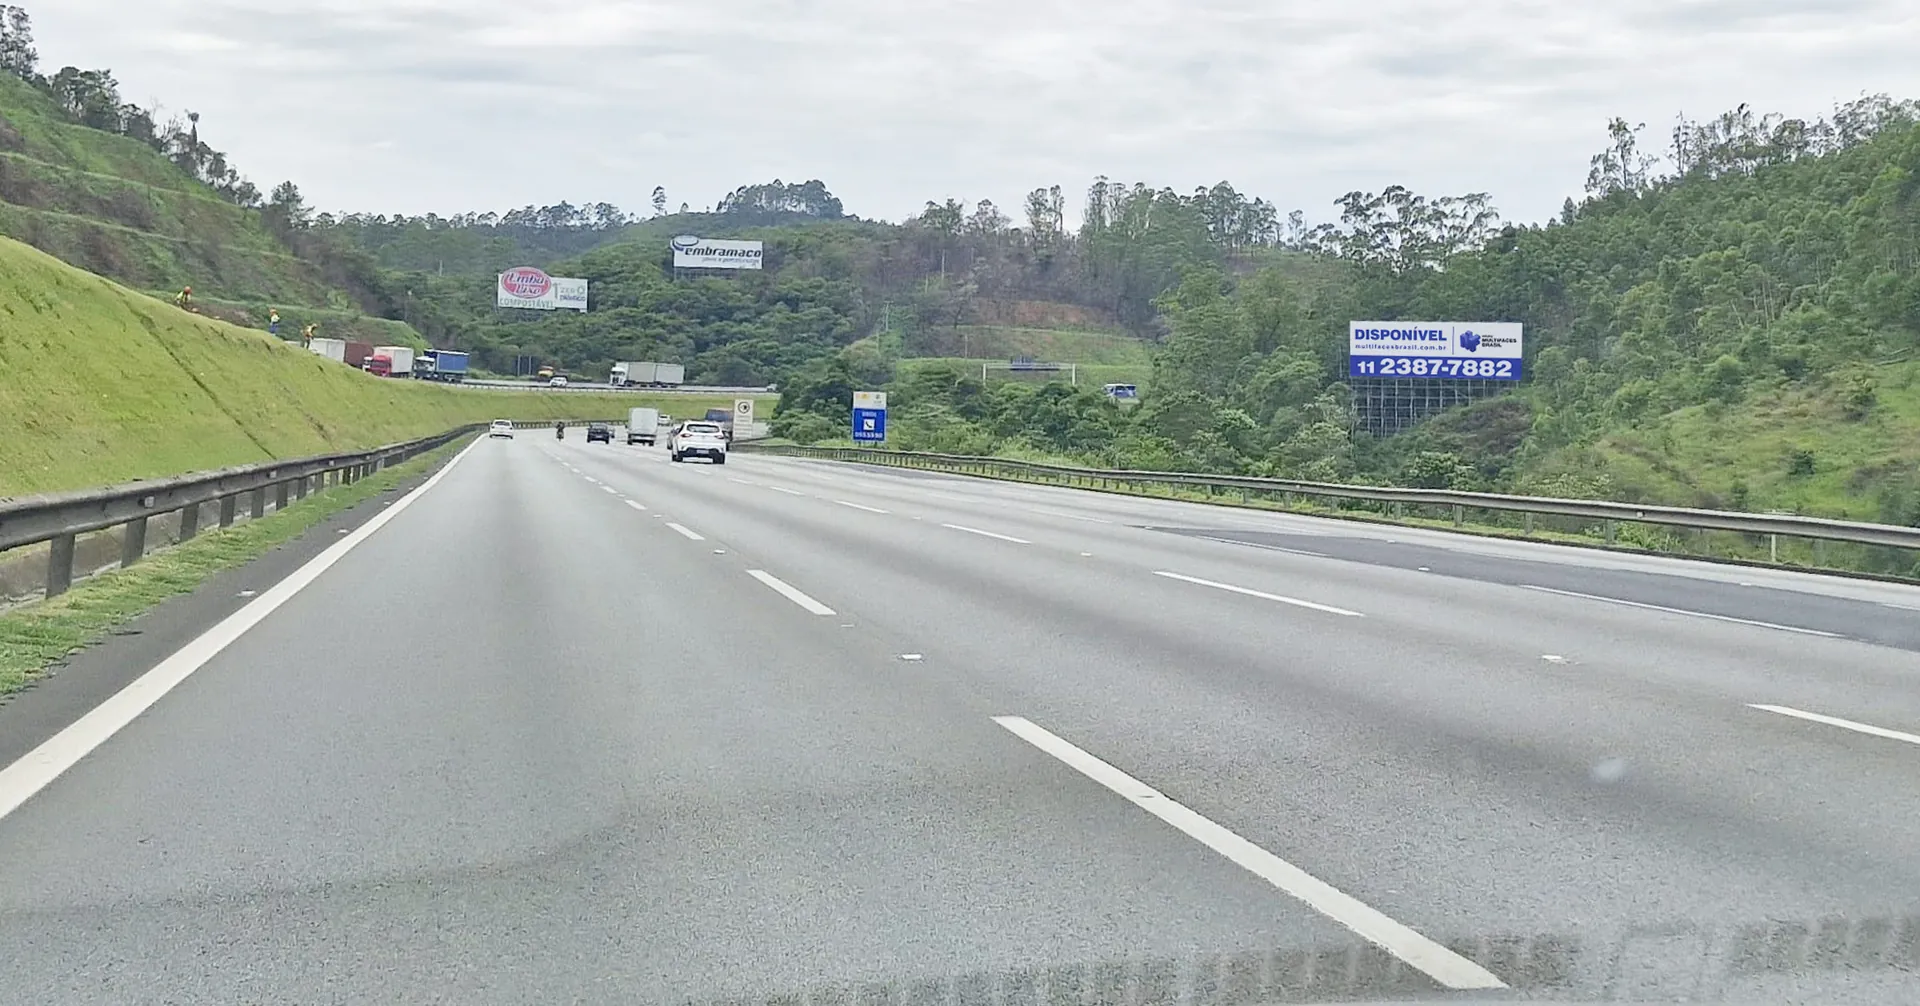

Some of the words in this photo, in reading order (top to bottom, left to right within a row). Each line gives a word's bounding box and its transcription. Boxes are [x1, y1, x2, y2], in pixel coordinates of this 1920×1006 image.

[685, 246, 761, 257] embramaco
[499, 298, 553, 308] COMPOSTÁVEL
[1355, 327, 1447, 341] DISPONÍVEL
[1357, 361, 1375, 374] 11
[1380, 358, 1512, 377] 2387-7882
